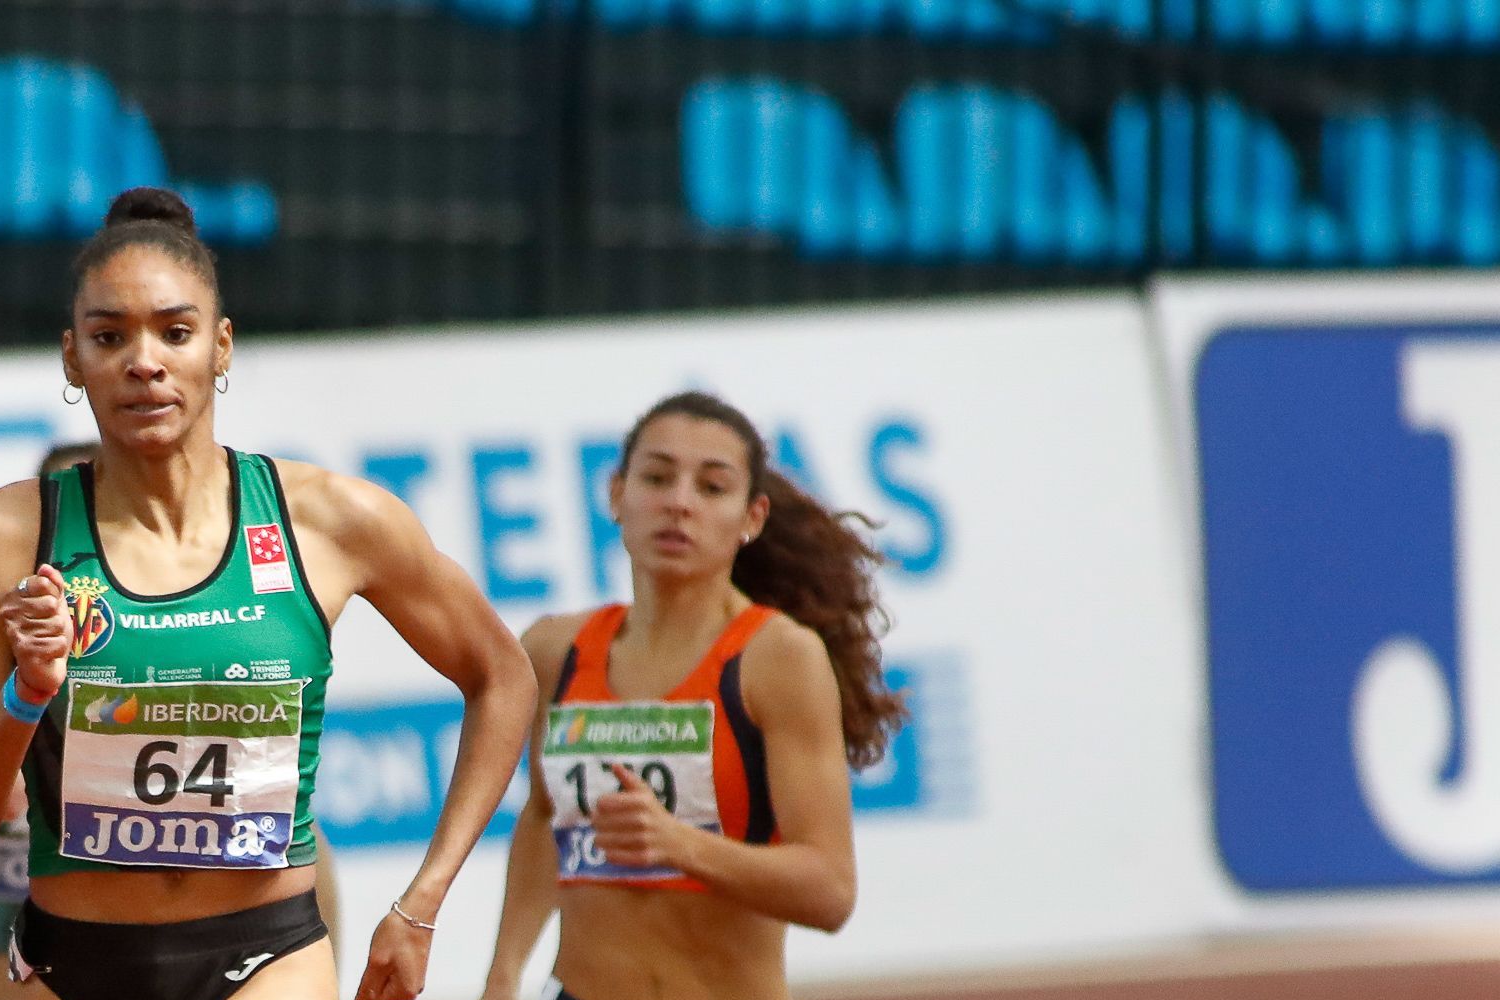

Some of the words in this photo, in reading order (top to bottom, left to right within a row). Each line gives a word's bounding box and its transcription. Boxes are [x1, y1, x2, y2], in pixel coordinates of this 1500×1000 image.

[119, 608, 236, 629] VILLARREAL
[158, 667, 202, 675] GENERALITAT
[250, 665, 291, 673] TRINIDAD
[67, 670, 117, 678] COMUNITAT
[158, 673, 202, 681] VALENCIANA
[252, 672, 291, 680] ALFONSO
[143, 702, 288, 724] IBERDROLA
[133, 740, 234, 809] 64
